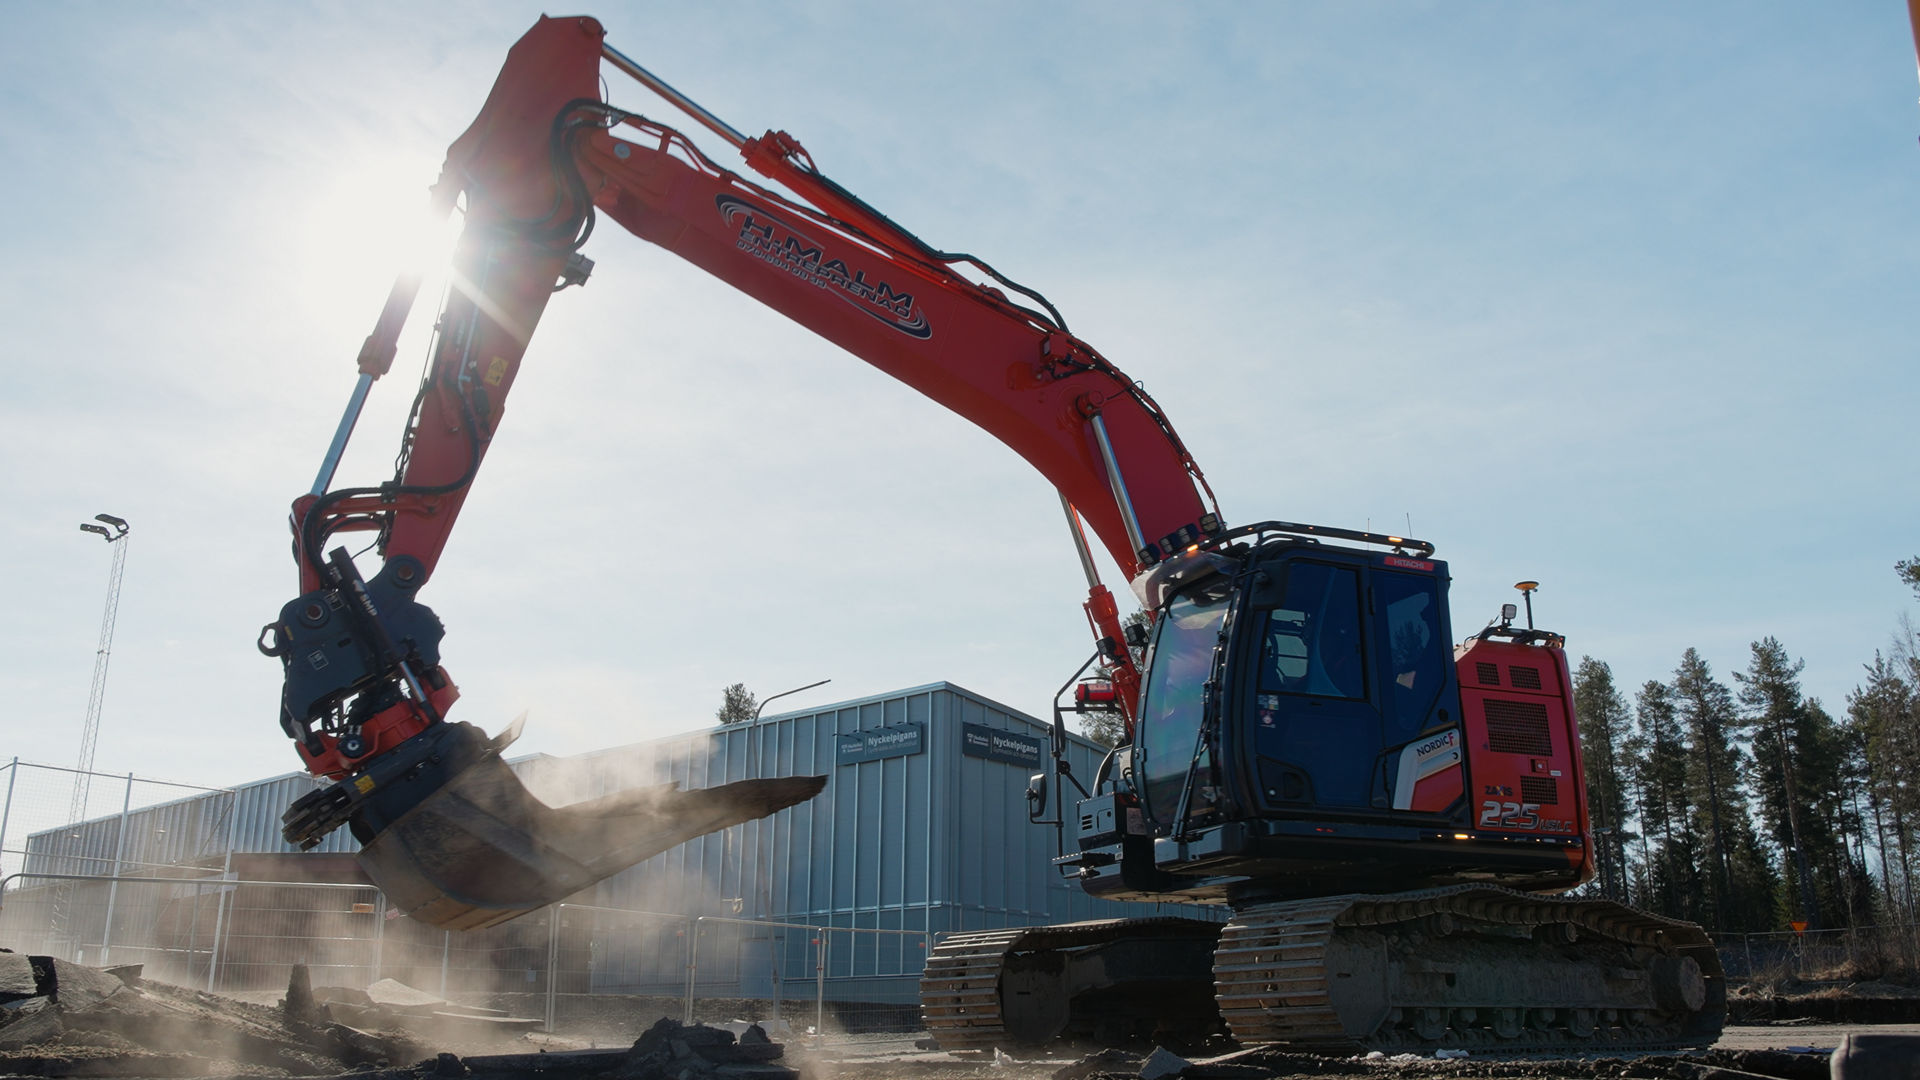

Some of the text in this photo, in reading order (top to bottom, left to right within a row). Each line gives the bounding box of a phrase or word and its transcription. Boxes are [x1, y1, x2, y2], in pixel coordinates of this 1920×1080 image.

[743, 215, 915, 311] H.MALM
[738, 229, 911, 319] ENTREPRENAD
[1393, 559, 1425, 569] HITACHI
[867, 731, 918, 746] Nyckelpigans
[993, 736, 1038, 754] Nyckelpigans
[1485, 784, 1513, 796] ZAXIS
[1480, 801, 1541, 830] 225
